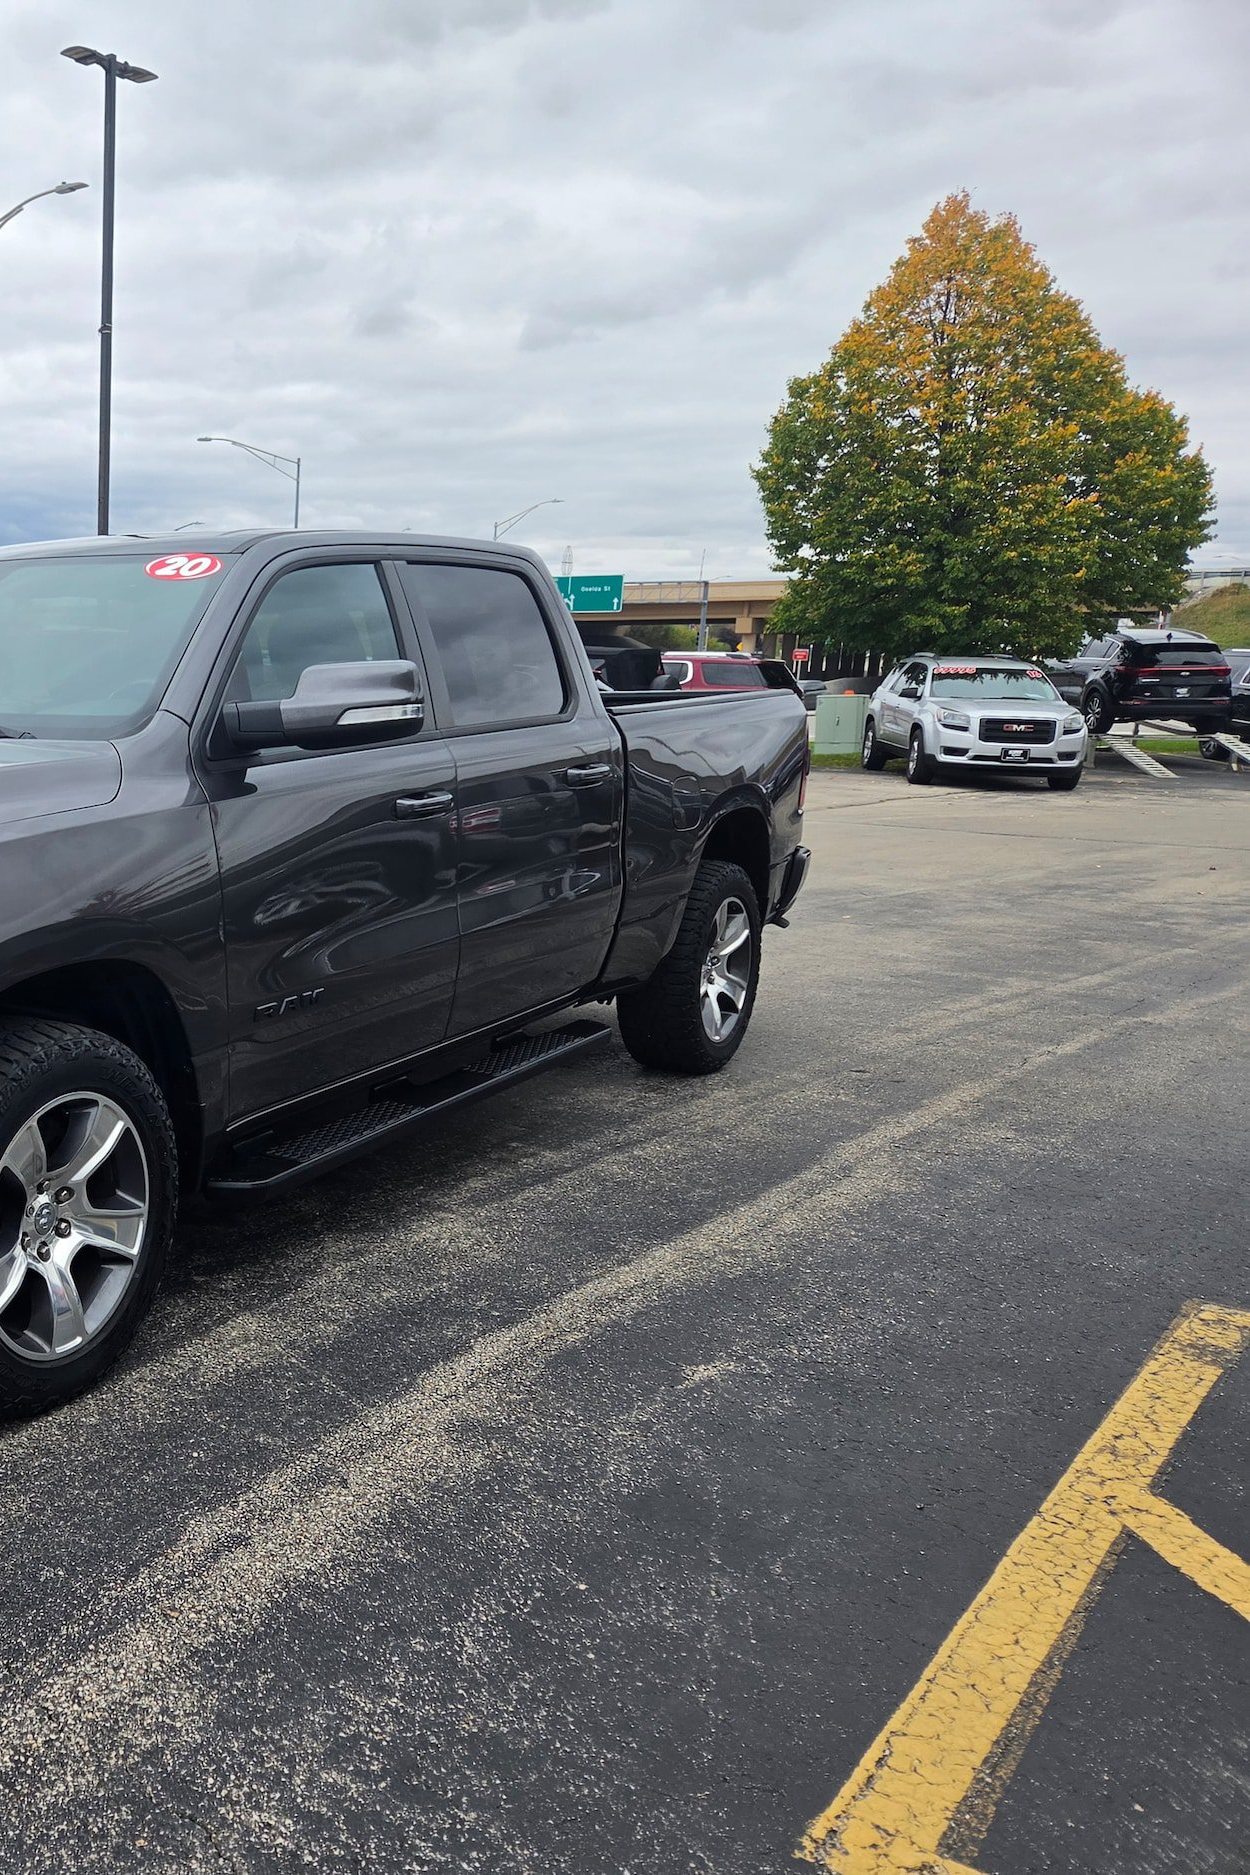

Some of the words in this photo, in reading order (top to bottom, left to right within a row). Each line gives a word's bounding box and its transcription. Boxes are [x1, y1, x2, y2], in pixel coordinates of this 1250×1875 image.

[154, 556, 212, 577] 20
[1002, 724, 1035, 732] GMC
[254, 988, 325, 1021] RAM
